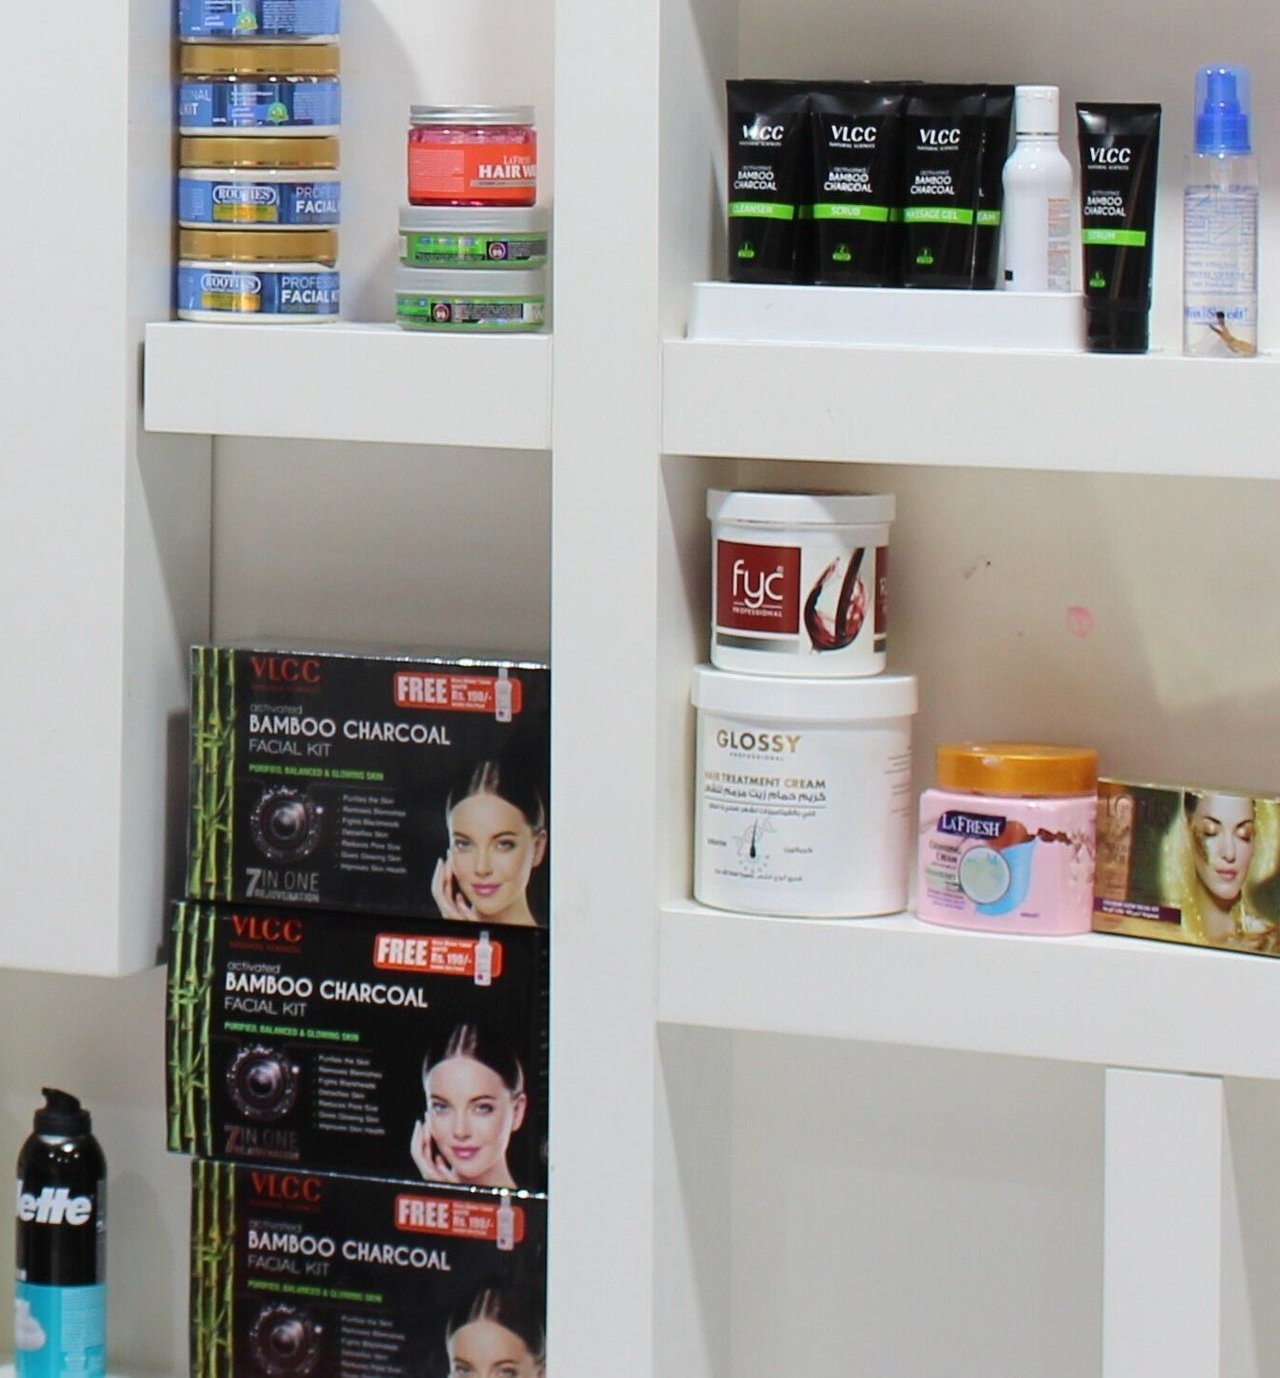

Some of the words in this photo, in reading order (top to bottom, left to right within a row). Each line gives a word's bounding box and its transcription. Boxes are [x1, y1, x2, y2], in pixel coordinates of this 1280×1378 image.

[831, 124, 877, 143] VLCC
[919, 128, 961, 145] VLCC
[1090, 147, 1131, 164] VLCC
[478, 165, 522, 179] HAIR
[737, 171, 775, 181] BAMBOO
[828, 172, 870, 183] BAMBOO
[914, 175, 952, 185] BAMBOO
[733, 180, 778, 191] CHARCOAL
[823, 181, 873, 194] CHARCOAL
[910, 184, 956, 196] CHARCOAL
[295, 200, 337, 214] FACIAL
[1087, 196, 1123, 207] BAMBOO
[831, 206, 861, 217] SCRUB
[941, 210, 959, 221] GEL
[1084, 206, 1126, 217] CHARCOAL
[281, 290, 330, 304] FACIAL
[731, 558, 784, 609] fyc
[732, 606, 783, 618] PROFESSIONAL
[250, 655, 322, 683] VLCC
[397, 675, 448, 704] FREE
[249, 714, 337, 738] BAMBOO
[343, 720, 451, 746] CHARCOAL
[249, 738, 302, 756] FACIAL
[307, 742, 333, 757] KIT
[716, 729, 802, 753] GLOSSY
[721, 772, 780, 788] TREATMENT
[783, 778, 827, 790] CREAM
[245, 867, 262, 898] 7
[262, 870, 279, 888] IN
[284, 871, 320, 892] ONE
[231, 913, 303, 943] VLCC
[376, 937, 428, 967] FREE
[227, 961, 281, 974] activated
[225, 971, 313, 998] BAMBOO
[319, 979, 429, 1009] CHARCOAL
[224, 996, 279, 1015] FACIAL
[282, 1002, 308, 1017] KIT
[223, 1124, 240, 1155] 7
[250, 1170, 323, 1203] VLCC
[397, 1198, 450, 1230] FREE
[248, 1229, 335, 1258] BAMBOO
[342, 1239, 451, 1272] CHARCOAL
[248, 1254, 301, 1274] FACIAL
[305, 1261, 330, 1277] KIT
